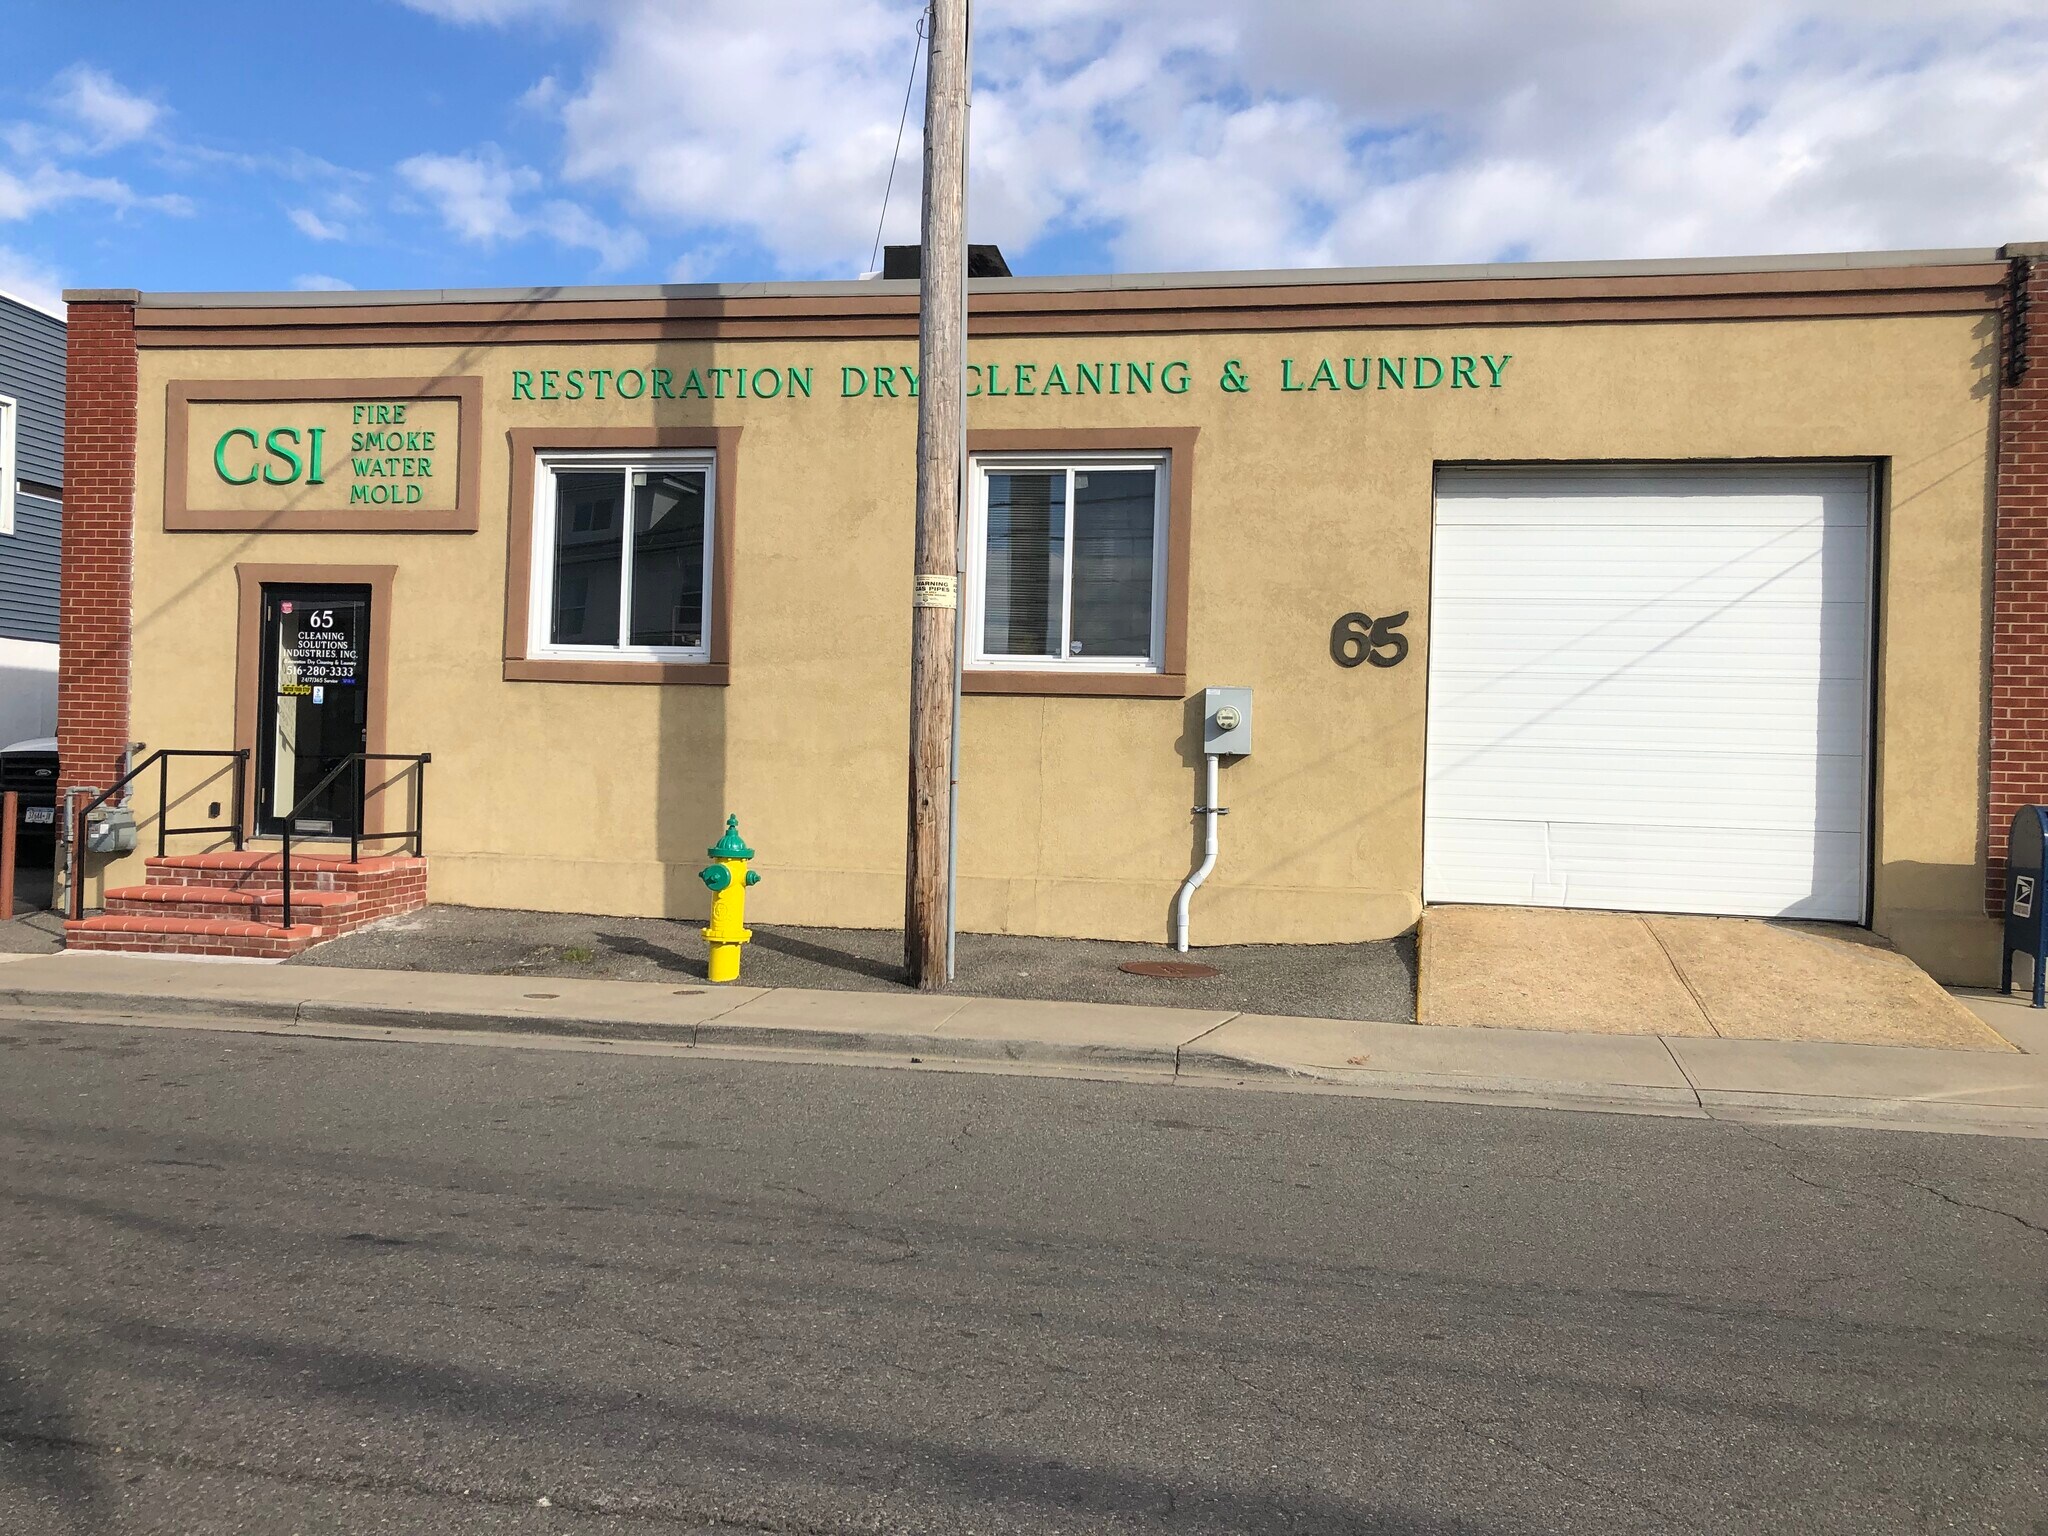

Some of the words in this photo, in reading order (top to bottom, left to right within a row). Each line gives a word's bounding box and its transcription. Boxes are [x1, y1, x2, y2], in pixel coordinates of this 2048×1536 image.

[512, 367, 814, 401] RESTORATION
[841, 366, 920, 398] DRY
[966, 361, 1192, 397] CLEANING
[1219, 359, 1251, 393] &
[1281, 354, 1512, 392] LAUNDRY
[353, 404, 407, 425] FIRE
[351, 431, 436, 452] SMOKE
[213, 426, 327, 486] CSI
[352, 457, 433, 478] WATER
[350, 484, 424, 504] MOLD
[310, 610, 334, 628] 65
[297, 640, 348, 649] SOLUTIONS
[298, 631, 345, 640] CLEANING
[1329, 610, 1409, 668] 65
[340, 650, 359, 658] INC.
[286, 665, 354, 677] 516-280-3333
